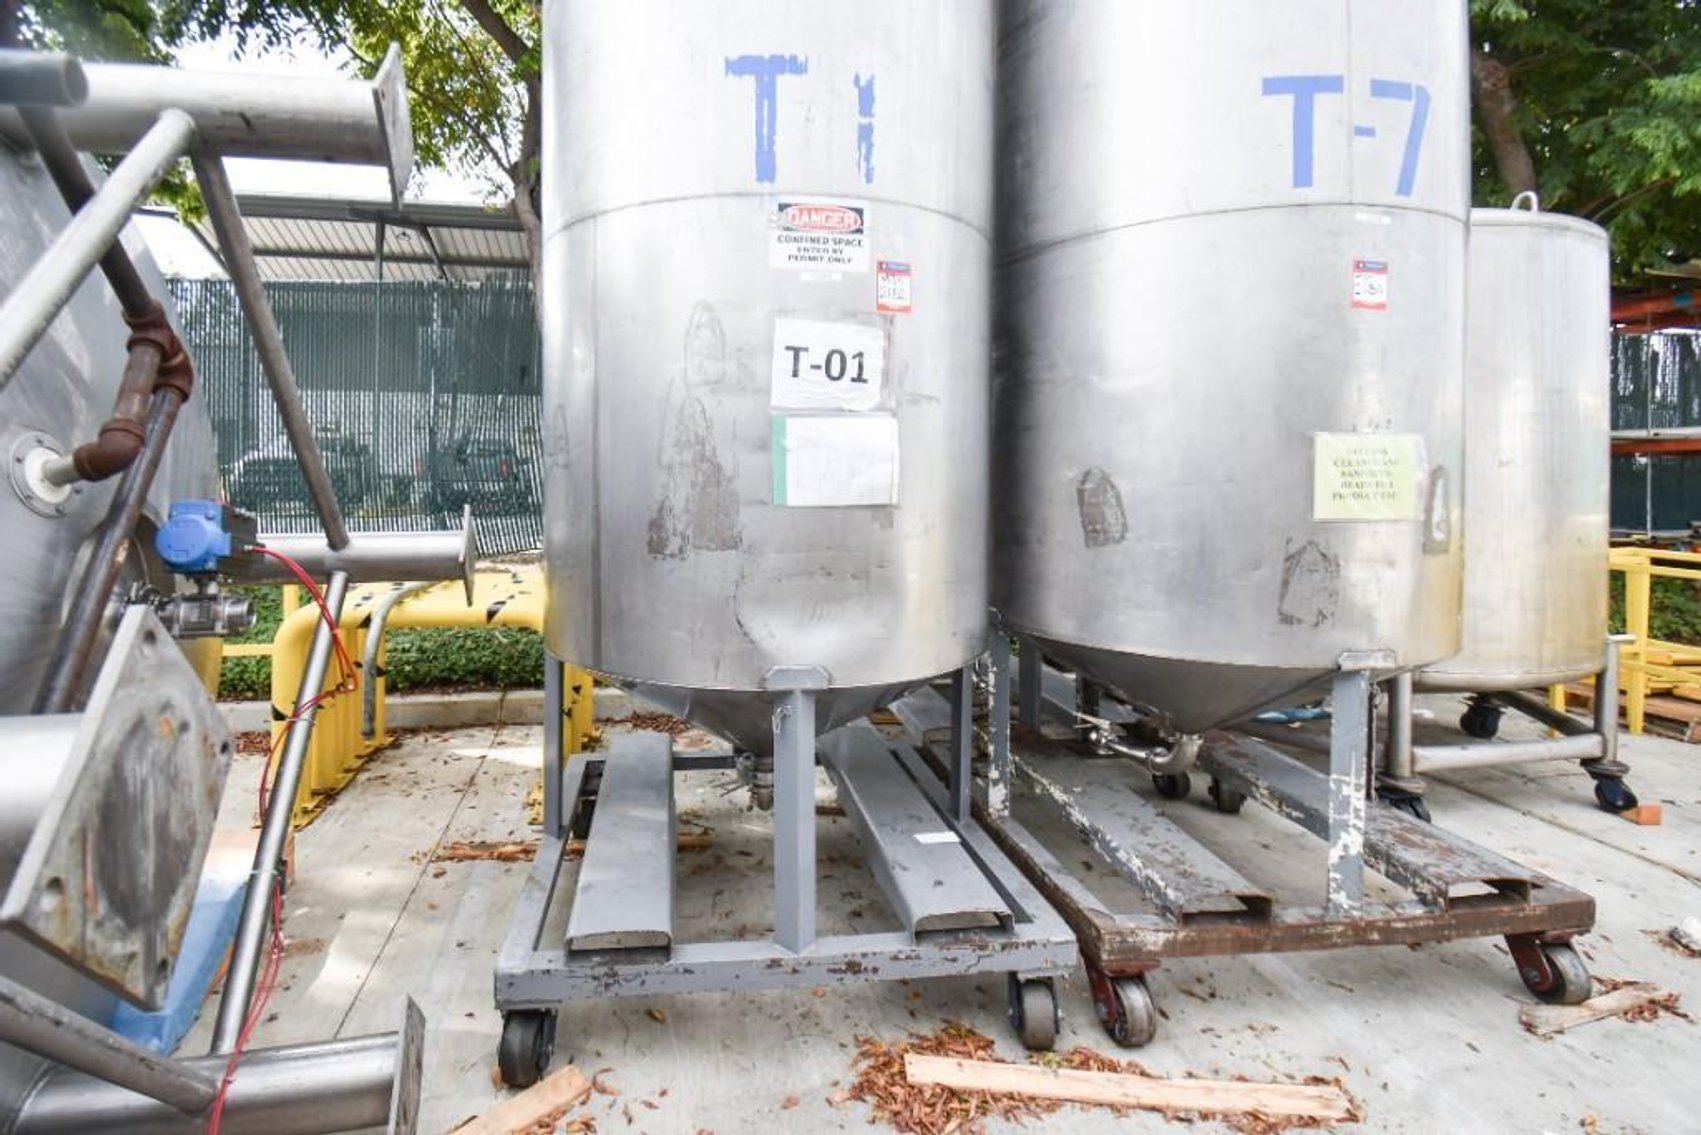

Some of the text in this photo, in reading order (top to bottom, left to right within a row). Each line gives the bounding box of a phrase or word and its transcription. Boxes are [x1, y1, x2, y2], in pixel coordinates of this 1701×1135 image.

[1262, 75, 1431, 197] T-7
[787, 207, 858, 229] DANGER
[777, 235, 864, 249] CONFINED SPACE
[796, 246, 829, 255] ENTER
[788, 254, 853, 264] PERMIT ONLY
[784, 345, 869, 384] T-01
